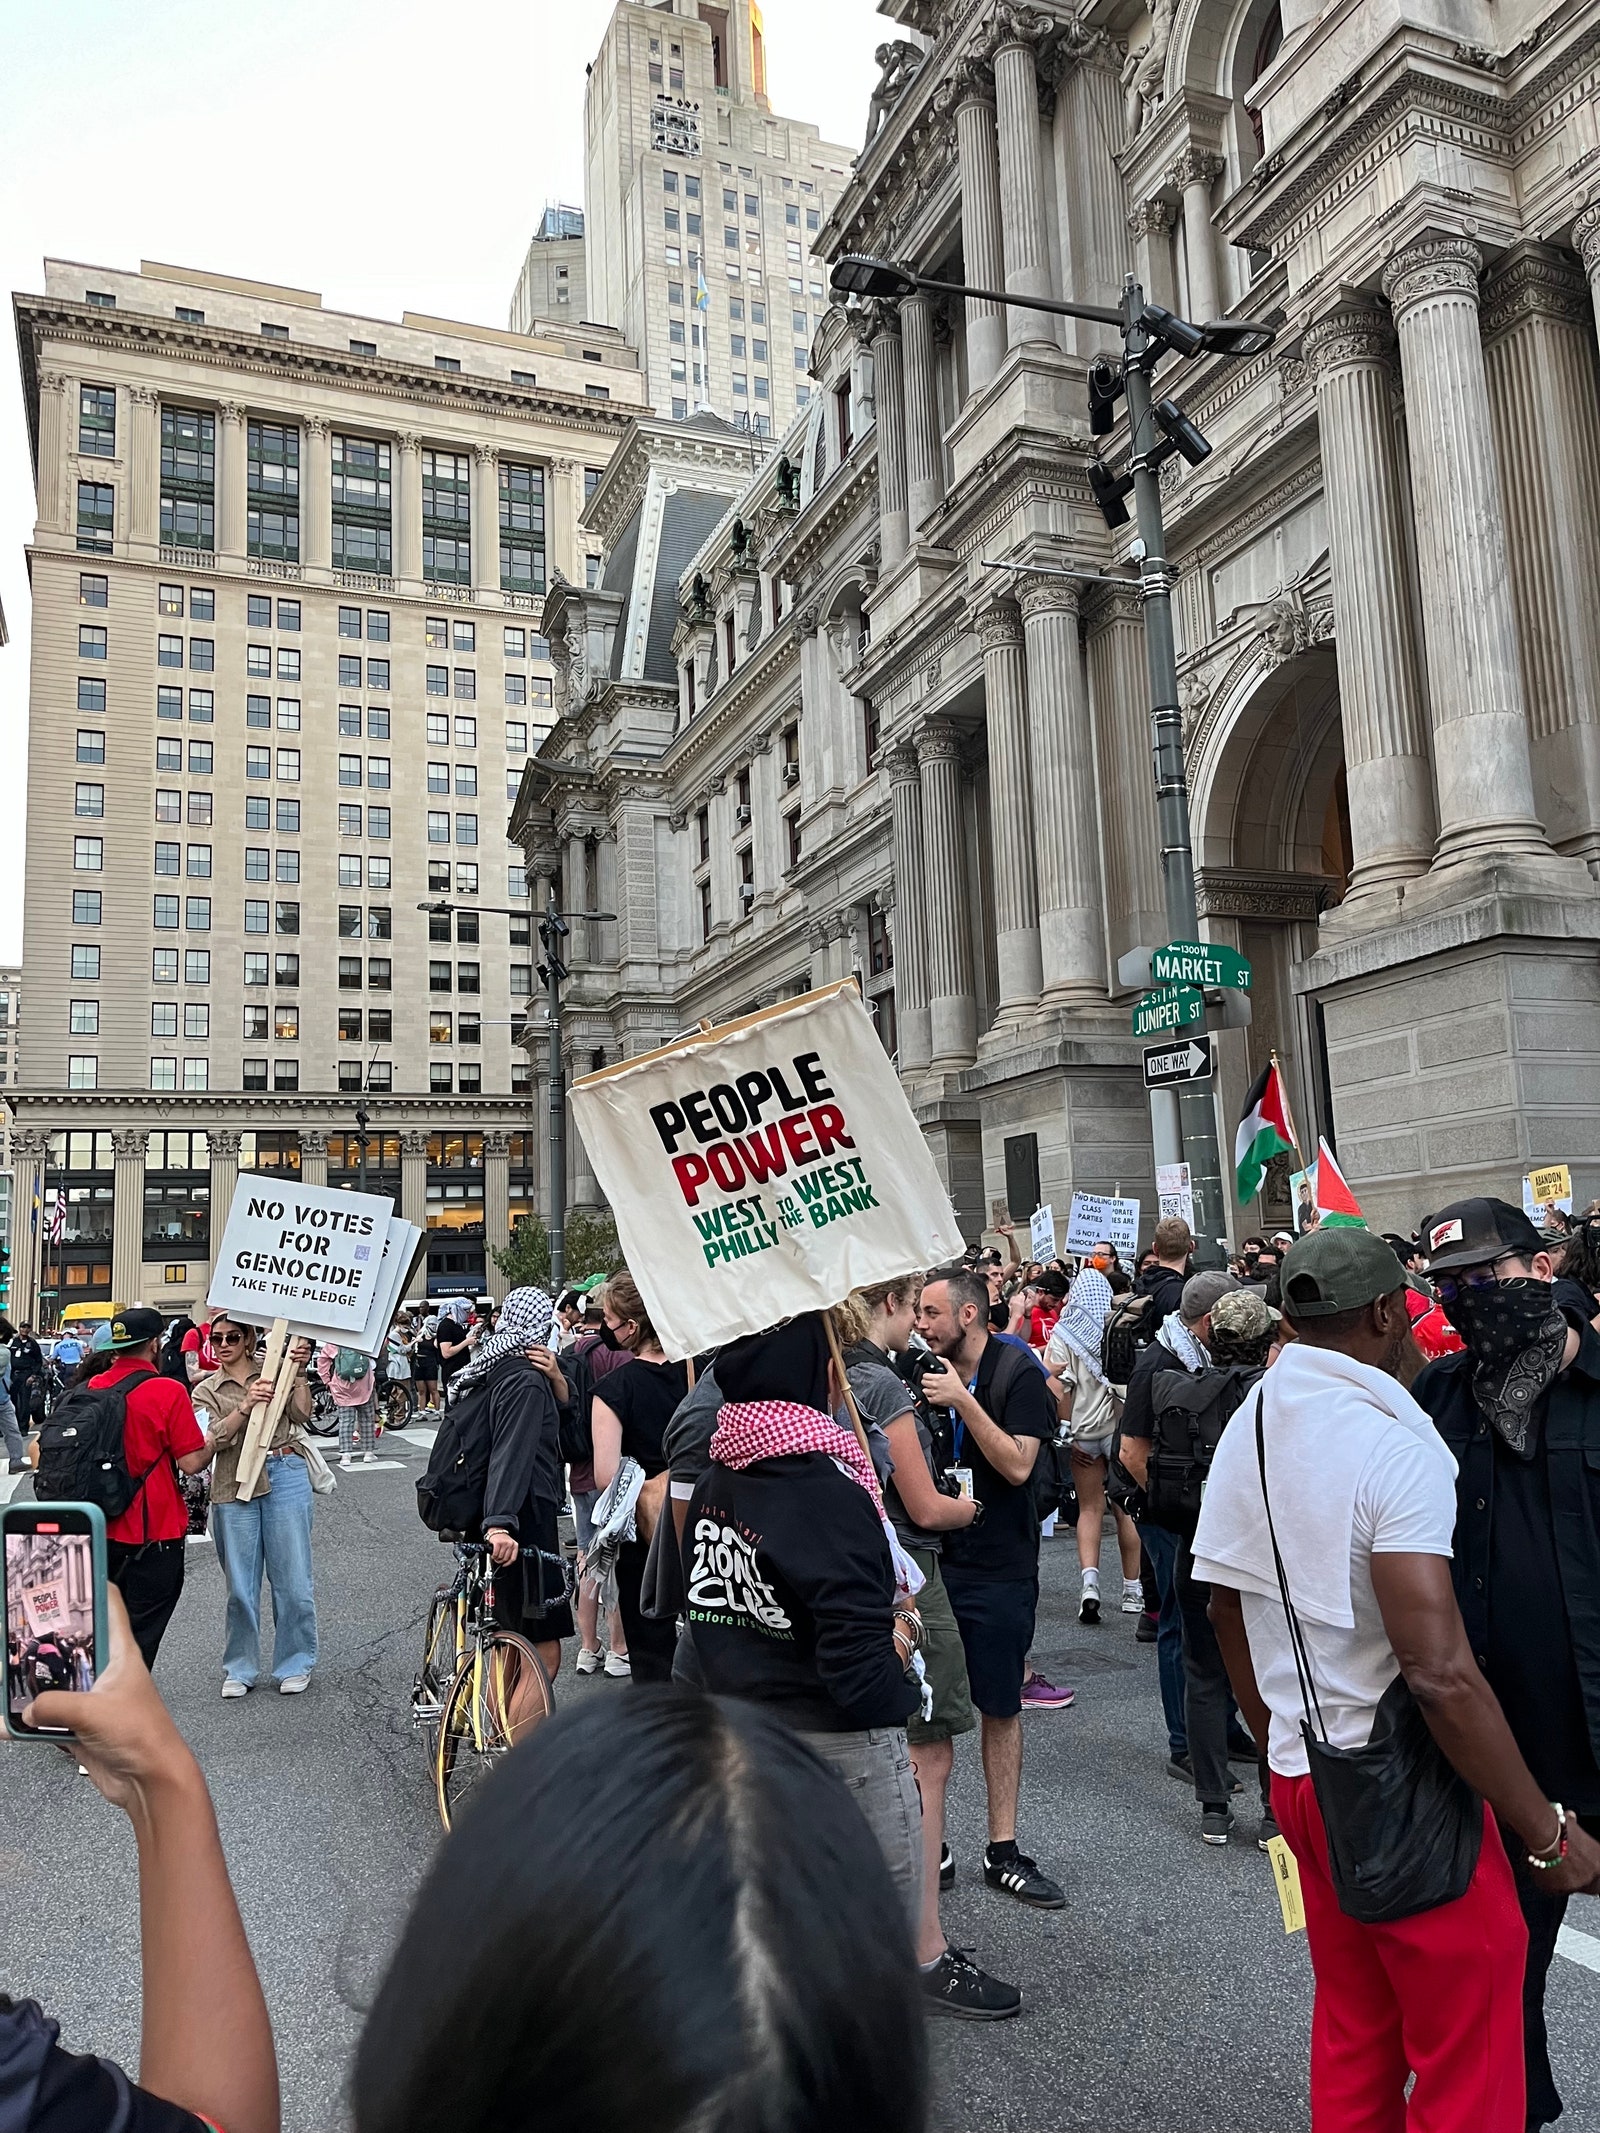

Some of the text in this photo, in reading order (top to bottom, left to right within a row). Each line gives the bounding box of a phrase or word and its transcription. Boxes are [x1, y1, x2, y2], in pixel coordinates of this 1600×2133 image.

[1156, 956, 1249, 986] MARKET ST
[1136, 1002, 1200, 1034] JUNIPER ST
[1151, 1052, 1190, 1074] ONE WAY
[649, 1052, 835, 1154] PEOPLE
[155, 1108, 530, 1121] WIDENER BUILDIN
[672, 1104, 856, 1207] POWER
[791, 1157, 866, 1205] WEST
[1535, 1172, 1562, 1186] ABANDON
[776, 1196, 794, 1215] TO
[808, 1184, 880, 1229] BANK
[1074, 1194, 1112, 1206] TWO RULING
[1082, 1204, 1102, 1214] CLASS
[247, 1198, 375, 1236] NO VOTES
[692, 1195, 767, 1241] WEST
[778, 1208, 804, 1230] THE
[1078, 1214, 1102, 1223] PARTIES
[278, 1230, 330, 1257] FOR
[702, 1222, 780, 1268] PHILLY
[1068, 1238, 1096, 1246] DEMOCRA
[236, 1250, 362, 1288] GENOCIDE
[231, 1276, 356, 1306] TAKE THE PLEDGE
[60, 1342, 79, 1350] POLICE
[700, 1504, 726, 1518] Join
[32, 1590, 57, 1605] PEOPLE
[35, 1600, 59, 1614] POWER
[690, 1610, 734, 1624] Before
